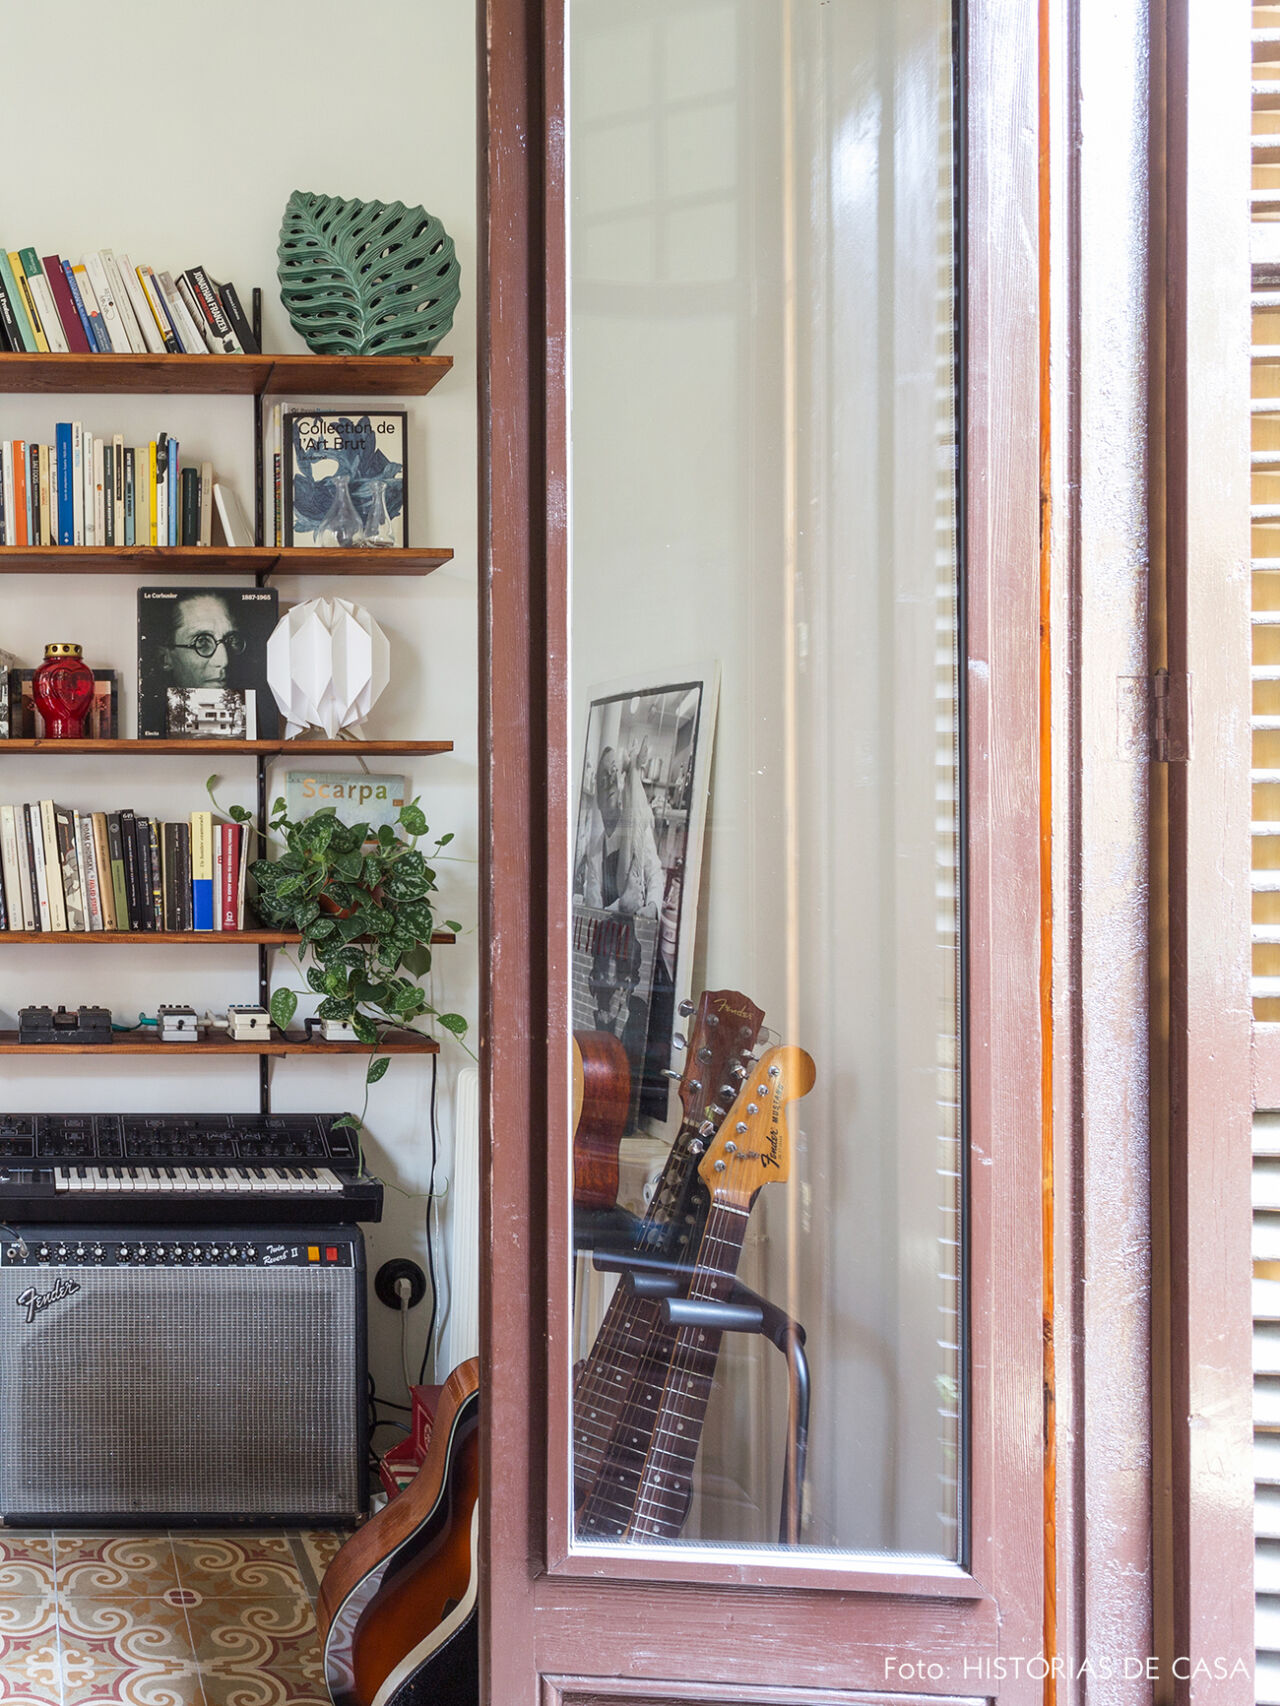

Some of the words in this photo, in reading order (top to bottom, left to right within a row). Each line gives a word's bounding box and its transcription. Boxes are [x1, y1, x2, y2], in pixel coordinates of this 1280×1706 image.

[0, 298, 12, 325] Profumo
[192, 271, 214, 303] JONATHAN
[207, 302, 229, 332] FRANZEN
[298, 421, 372, 435] Collection
[377, 421, 395, 434] de
[299, 438, 328, 451] l'Art
[334, 438, 366, 450] Brut
[303, 778, 387, 805] Scarpa
[83, 823, 91, 841] NOAM
[88, 879, 97, 896] FAILED
[713, 998, 753, 1020] Fender
[771, 1082, 784, 1124] MUSTANG
[761, 1126, 780, 1170] Fender
[266, 1244, 285, 1254] Twin
[16, 1277, 81, 1324] Fender
